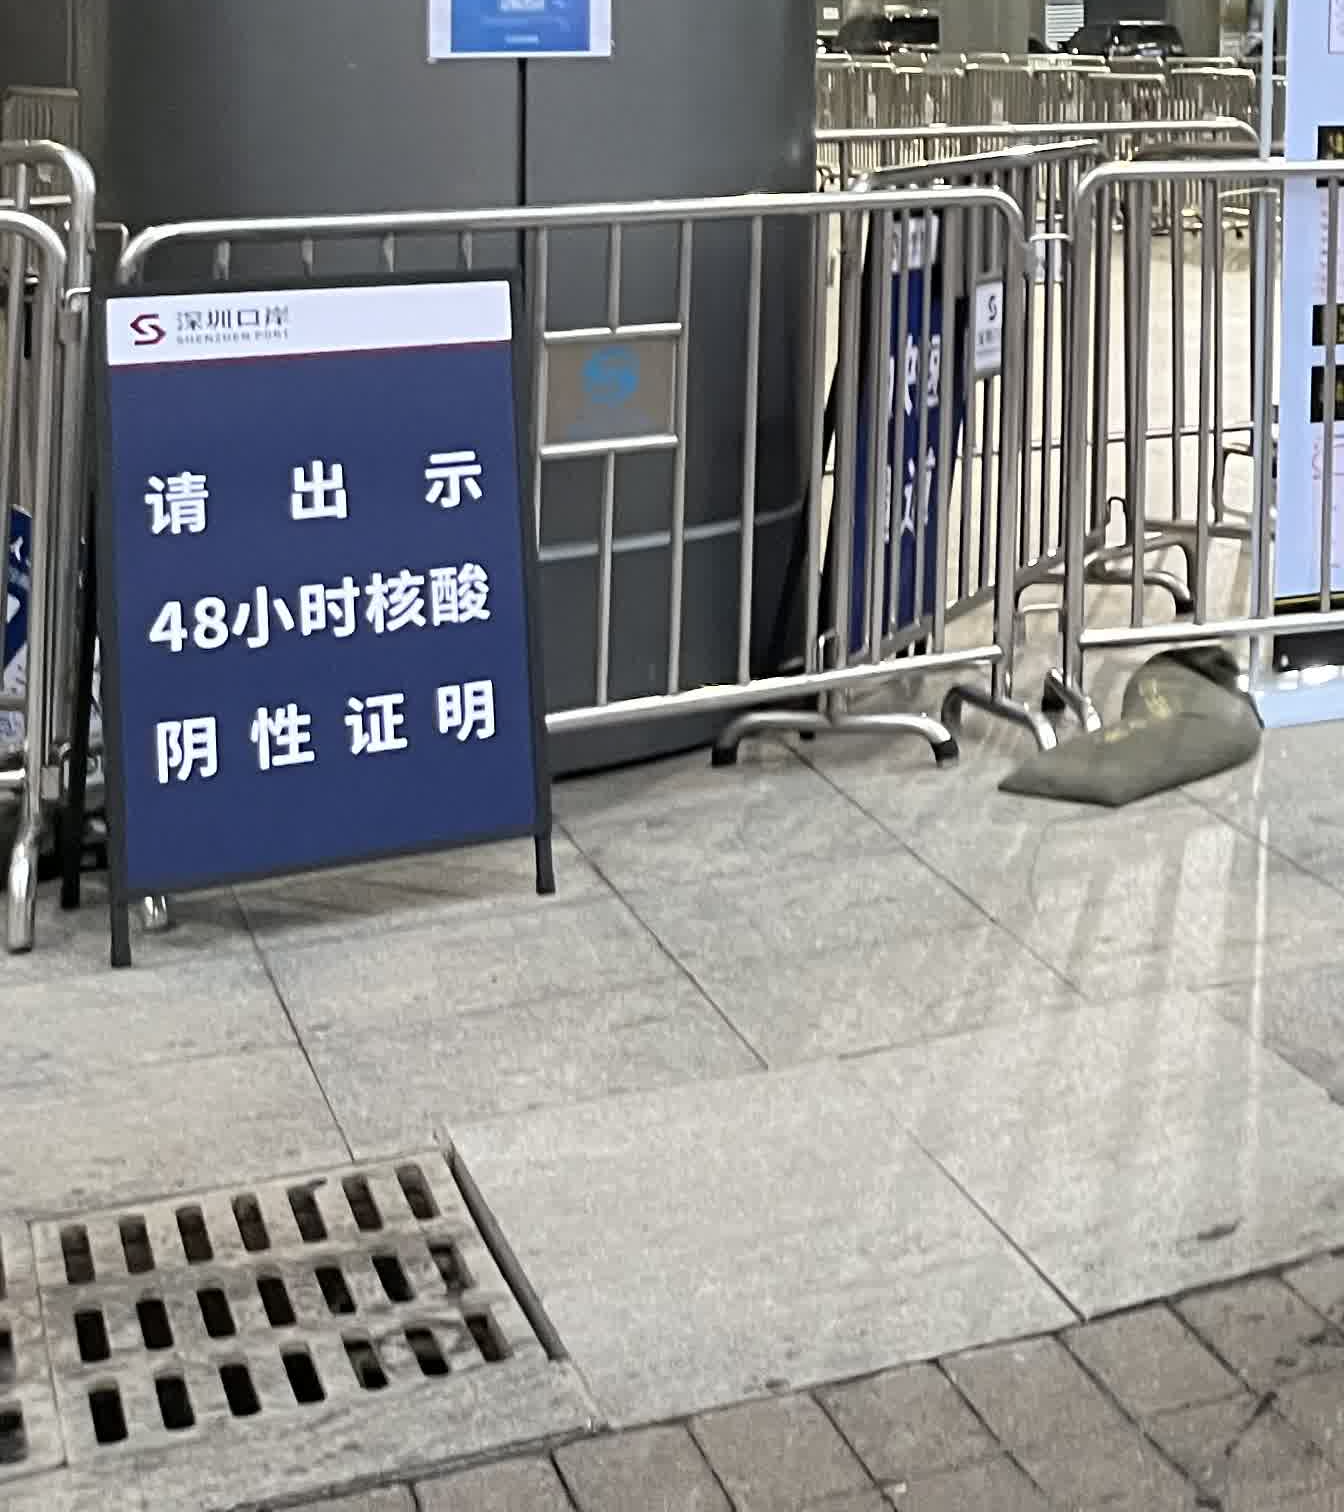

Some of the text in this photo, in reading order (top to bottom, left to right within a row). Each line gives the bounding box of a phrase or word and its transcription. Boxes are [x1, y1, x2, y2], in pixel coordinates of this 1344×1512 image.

[176, 307, 289, 331] 深圳口岸
[149, 563, 491, 653] 48小时核酸
[156, 680, 497, 784] 阴性证明
